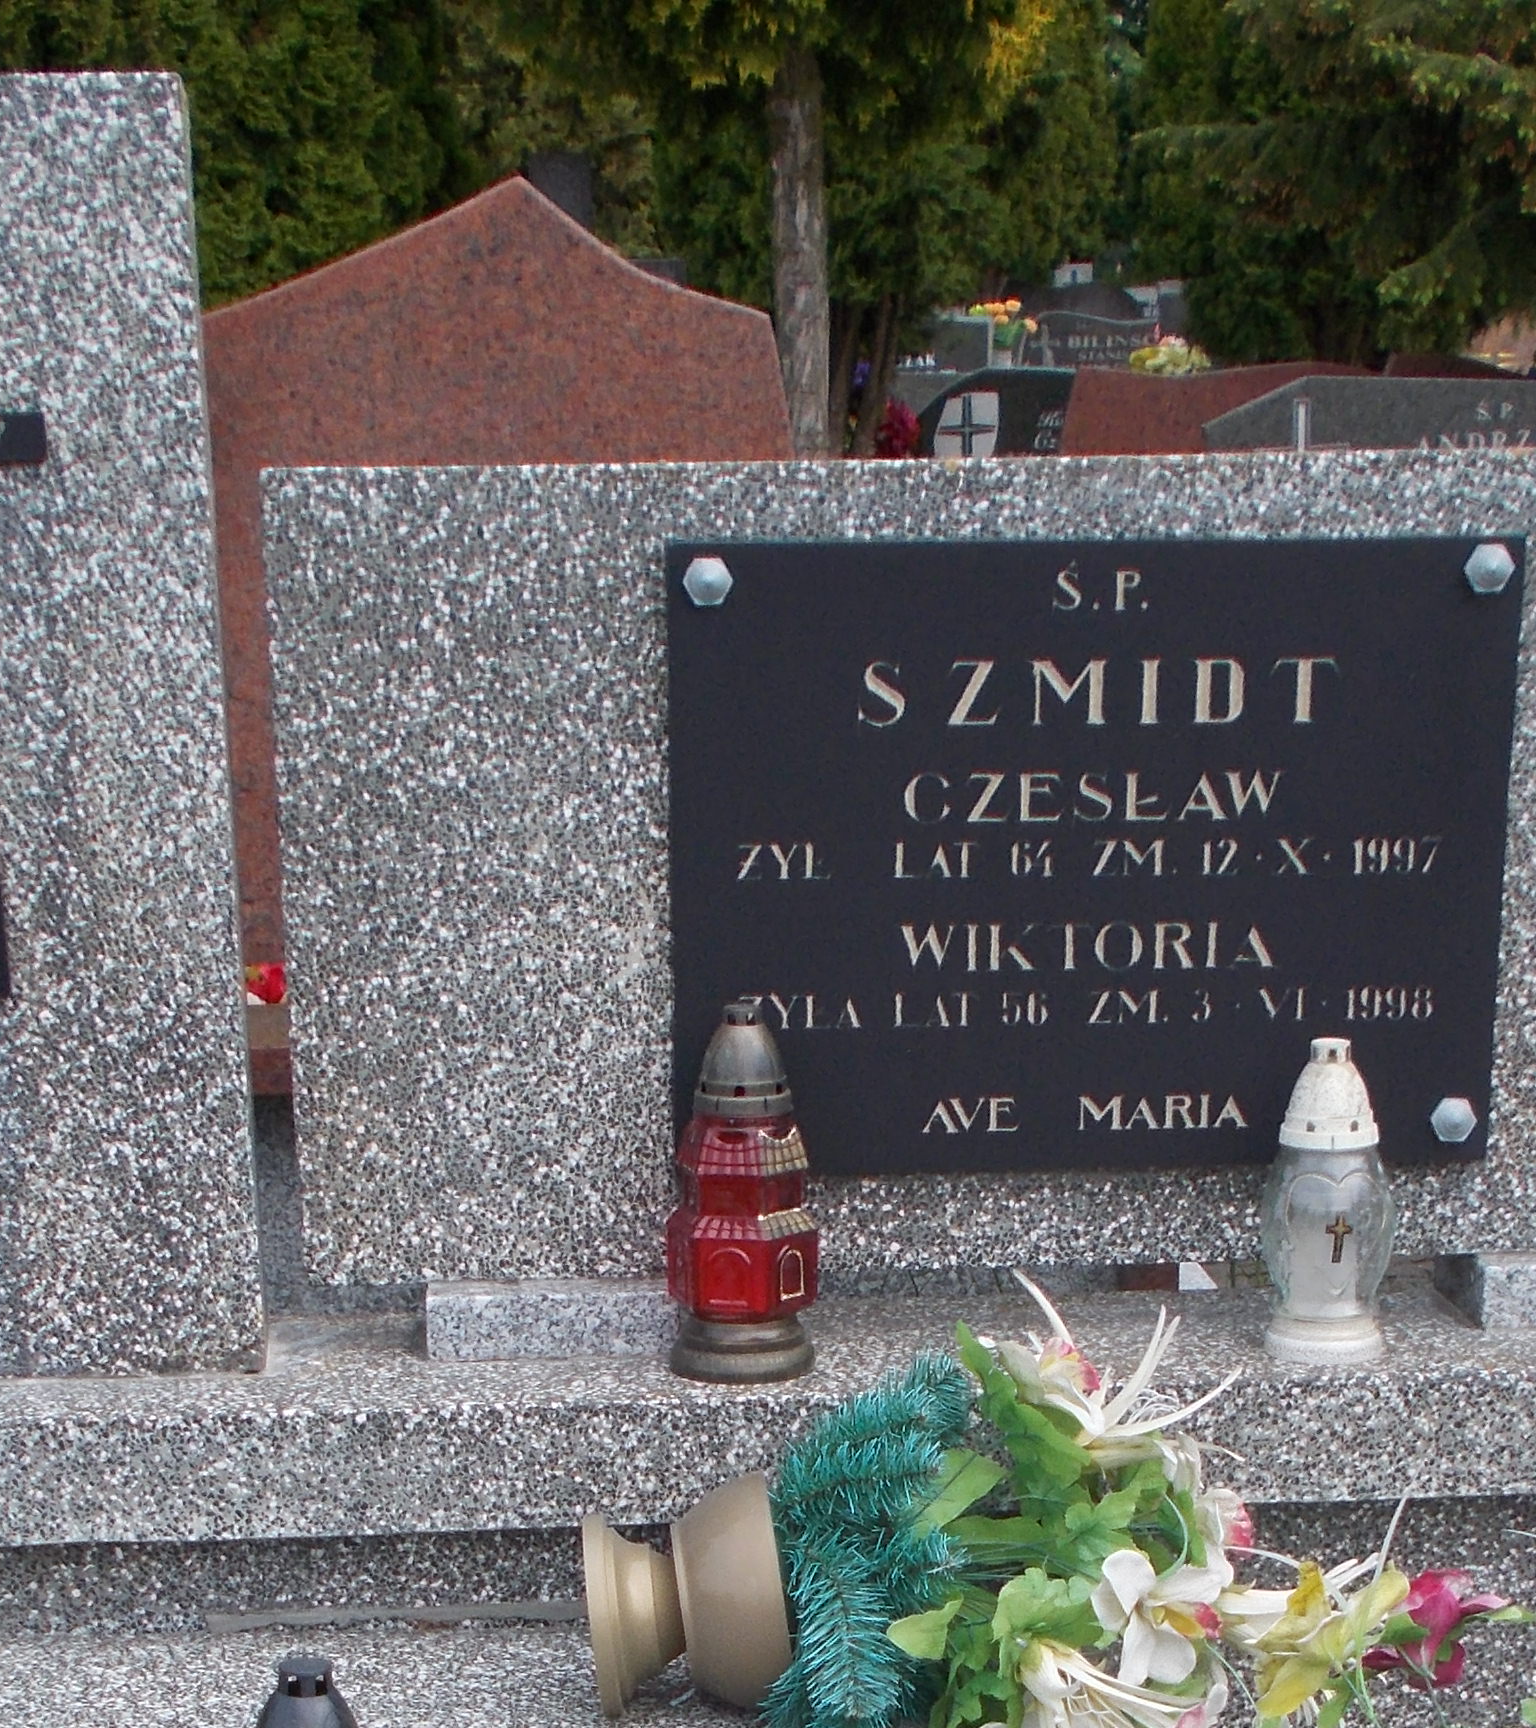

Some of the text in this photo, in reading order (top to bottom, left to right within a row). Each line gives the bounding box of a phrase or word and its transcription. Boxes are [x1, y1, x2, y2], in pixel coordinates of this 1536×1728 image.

[859, 657, 1340, 727] SZMIDT
[904, 770, 1281, 823] CZESŁAW
[894, 841, 977, 878] LAT
[1011, 840, 1053, 877] 64
[900, 921, 1276, 972] WIKTORIA
[893, 992, 976, 1028] LAT
[1002, 992, 1049, 1026] 56
[921, 1094, 1249, 1134] AVE MARIA
